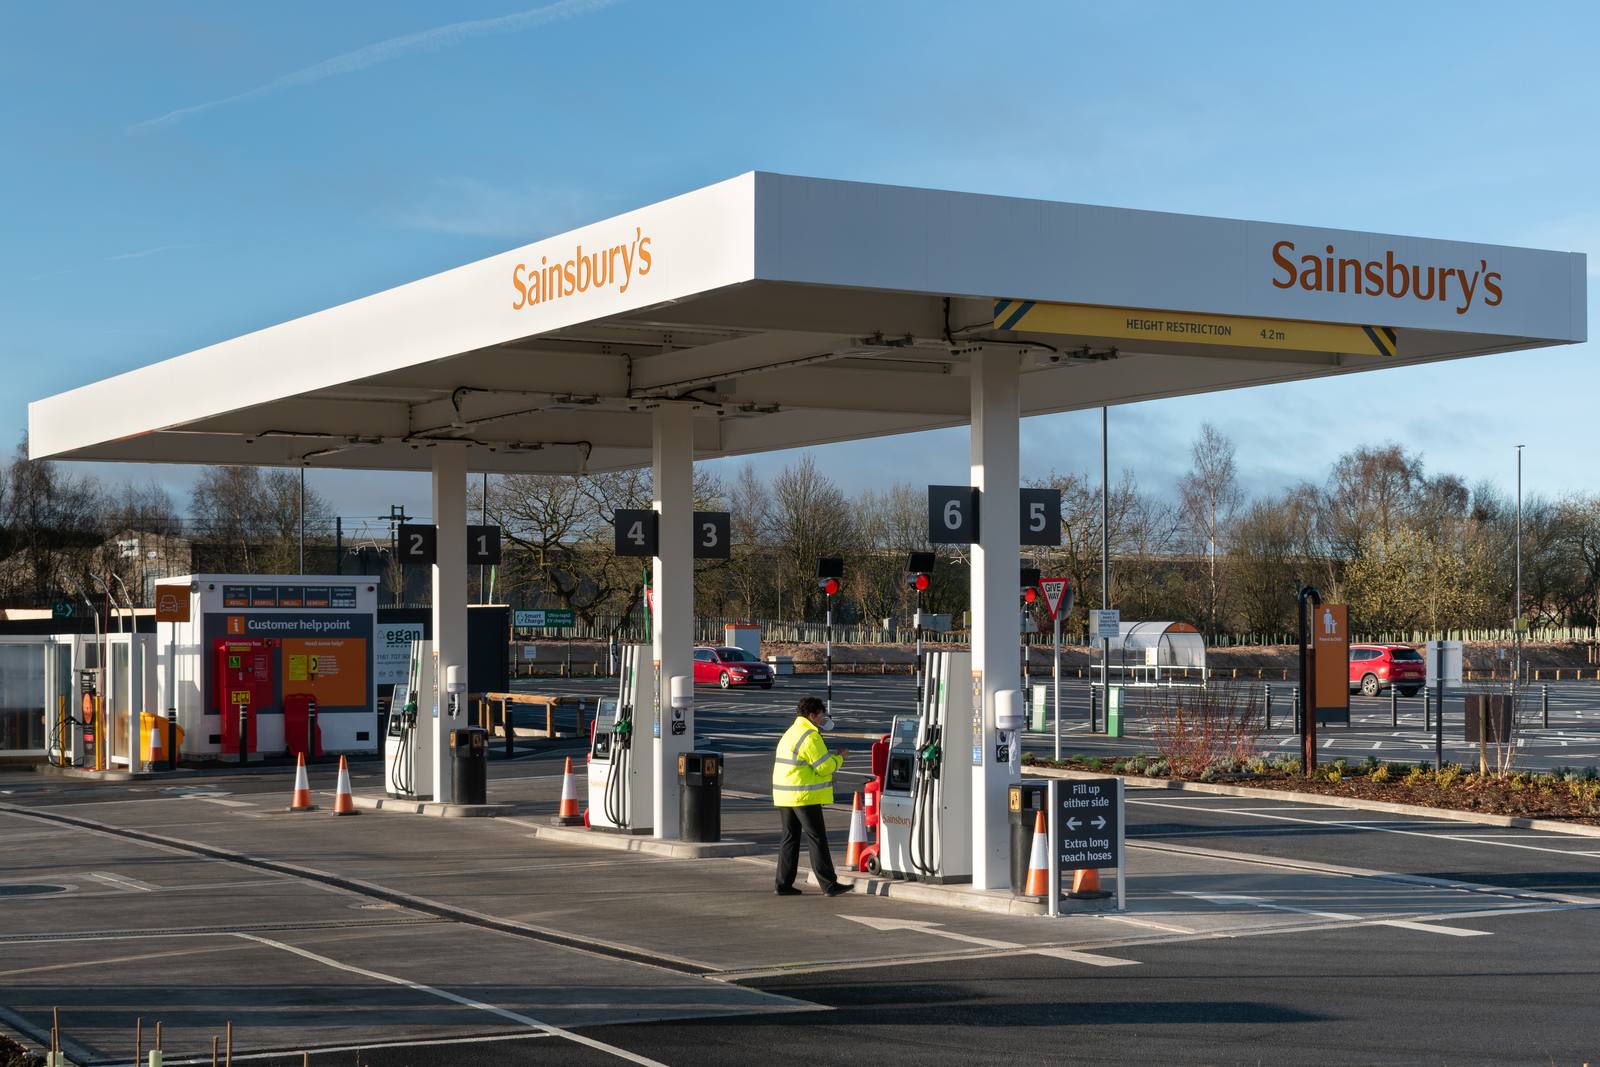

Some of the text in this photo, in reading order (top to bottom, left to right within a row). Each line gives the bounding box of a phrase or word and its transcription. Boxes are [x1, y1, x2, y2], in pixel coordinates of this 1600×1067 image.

[512, 227, 652, 310] Sainsbury's
[1271, 240, 1504, 315] Sainsbury's
[1126, 318, 1286, 341] HEIGHT RESTRICTION 4.2m
[943, 500, 963, 530] 6
[1029, 502, 1046, 532] 5
[627, 520, 645, 545] 4
[702, 523, 718, 548] 3
[409, 534, 424, 555] 2
[476, 535, 489, 556] 1
[1045, 583, 1061, 592] GIVE
[1047, 592, 1059, 600] WAY
[247, 618, 351, 632] Customer help point
[386, 629, 420, 644] egan
[1072, 784, 1100, 796] Fill up
[1063, 797, 1109, 808] either side
[1064, 838, 1109, 849] Extra long
[1061, 851, 1112, 862] reach hoses
